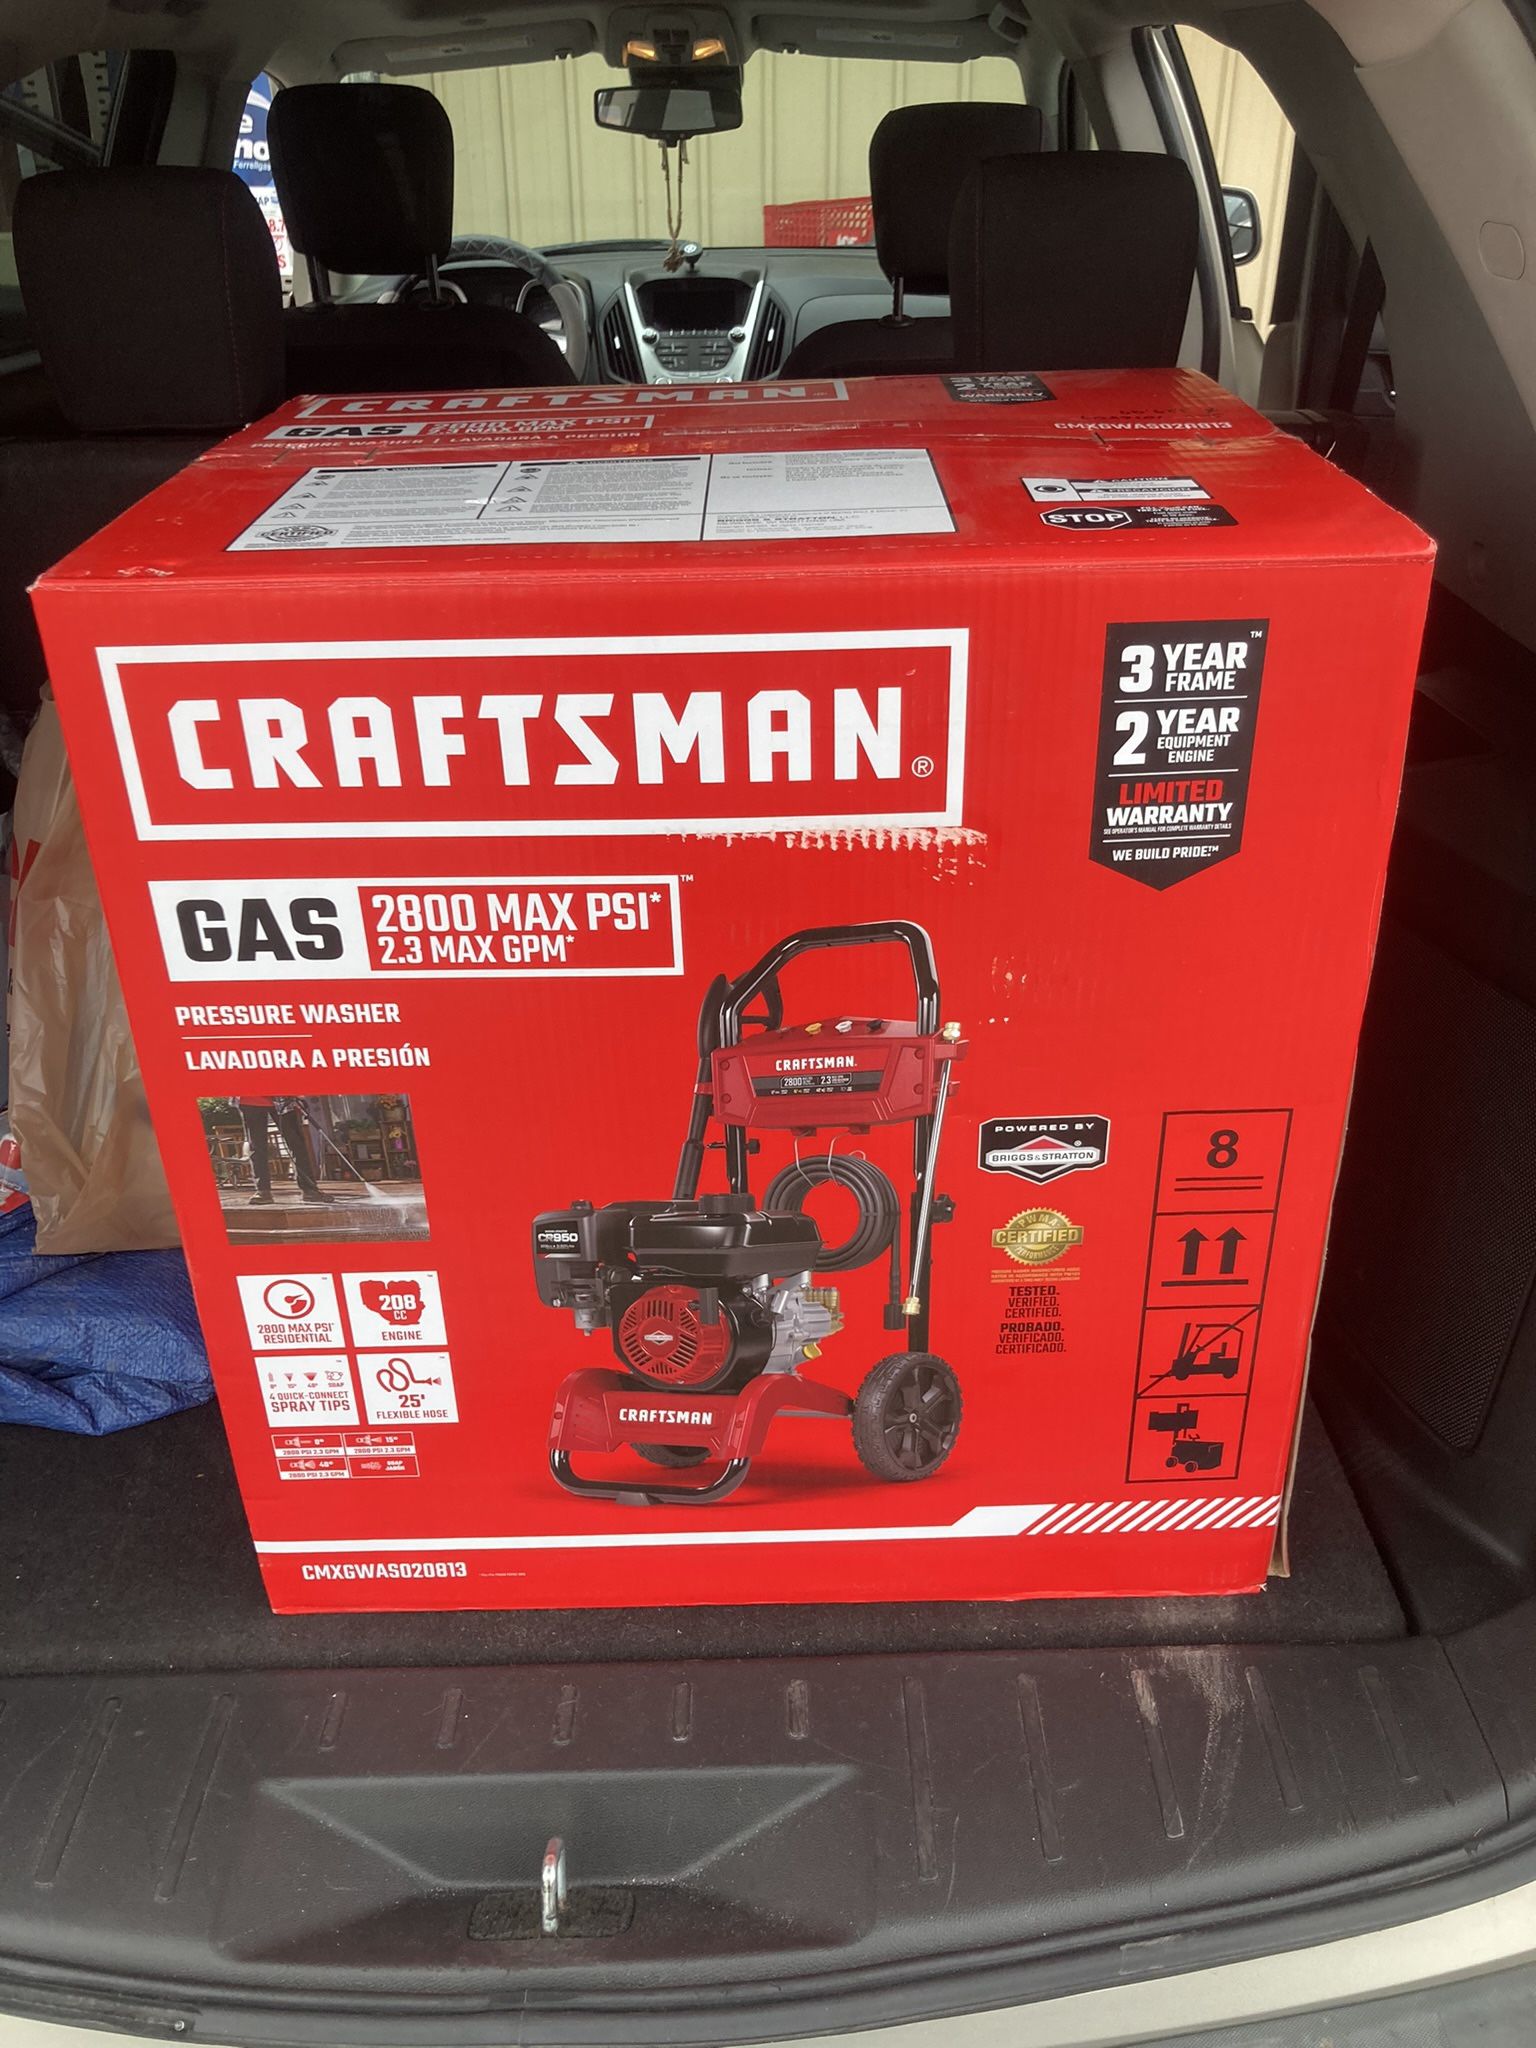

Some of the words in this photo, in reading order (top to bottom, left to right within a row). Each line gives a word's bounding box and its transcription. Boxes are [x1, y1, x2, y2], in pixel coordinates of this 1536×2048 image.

[341, 387, 806, 413] CRAFTSMAN
[284, 423, 408, 437] GAS
[1048, 513, 1125, 523] STOP
[1119, 644, 1155, 693] 3
[1162, 641, 1248, 672] YEAR
[1165, 670, 1236, 693] FRAME
[1113, 711, 1149, 766] 2
[1156, 707, 1240, 735] YEAR
[1157, 734, 1231, 750] EQUIPMENT
[1168, 749, 1215, 764] ENGINE
[1119, 780, 1224, 805] LIMITED
[1106, 802, 1233, 826] WARRANTY
[1166, 824, 1189, 832] COMPLETE
[1189, 823, 1214, 831] WARRANTY
[1112, 849, 1133, 861] WE
[1135, 847, 1171, 860] BUILD
[371, 892, 477, 934] 2800
[486, 892, 578, 932] MAX
[176, 897, 344, 962] GAS
[377, 935, 423, 965] 2.3
[431, 934, 497, 964] MAX
[175, 1004, 296, 1026] PRESSURE
[300, 1003, 401, 1024] WASHER
[184, 1048, 305, 1071] LAVADORA
[311, 1048, 328, 1068] A
[334, 1042, 431, 1068] PRESIÓN
[775, 1055, 857, 1072] CRAFTSMAN
[784, 1077, 803, 1086] 2800
[994, 1123, 1069, 1133] POWERED
[1074, 1122, 1096, 1131] BY
[1206, 1129, 1240, 1169] 8
[1017, 1213, 1059, 1228] PWMA
[538, 1232, 579, 1243] CR950
[995, 1229, 1079, 1244] CERTIFIED
[1009, 1285, 1060, 1297] TESTED.
[378, 1294, 417, 1311] 208
[1008, 1296, 1060, 1308] VERIFIED.
[393, 1310, 407, 1320] CC
[1005, 1307, 1062, 1319] CERTIFIED.
[257, 1323, 287, 1335] 2800
[288, 1323, 313, 1333] MAX
[1000, 1321, 1065, 1333] PROBADO.
[263, 1333, 332, 1344] RESIDENTIAL
[381, 1330, 423, 1341] ENGINE
[999, 1332, 1065, 1344] VERIFICADO.
[995, 1343, 1067, 1354] CERTIFICADO.
[277, 1391, 349, 1401] QUICK-CONNECT
[271, 1400, 316, 1413] SPRAY
[320, 1400, 350, 1411] TIPS
[376, 1410, 421, 1419] FLEXIBLE
[423, 1409, 449, 1418] HOSE
[619, 1408, 712, 1425] CRAFTSMAN
[301, 1562, 467, 1581] CMXGWAS020813
